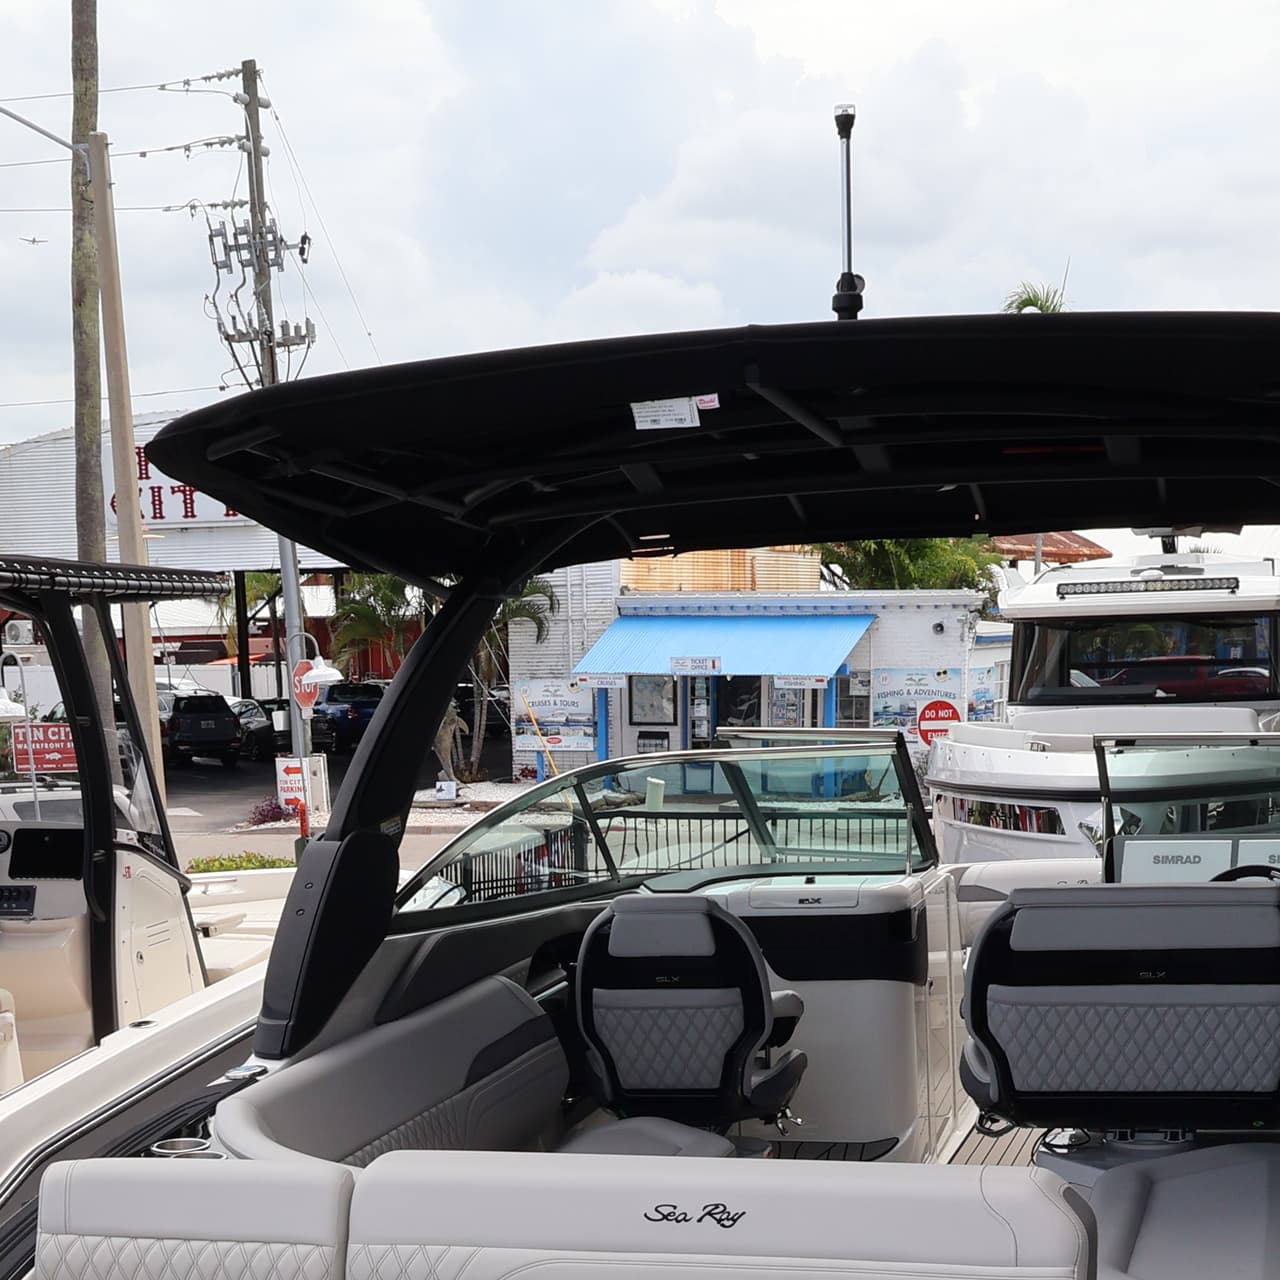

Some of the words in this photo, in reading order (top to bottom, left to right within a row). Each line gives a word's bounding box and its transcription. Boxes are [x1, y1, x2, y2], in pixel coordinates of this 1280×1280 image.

[877, 688, 904, 700] FISHING
[913, 687, 957, 700] ADVENTURES
[528, 699, 552, 708] CRUISES
[559, 699, 580, 708] TOURS
[925, 709, 936, 718] DO
[938, 709, 953, 718] NOT
[1152, 854, 1202, 865] SIMRAD
[643, 1203, 694, 1223] Sea
[696, 1203, 747, 1229] Ray
